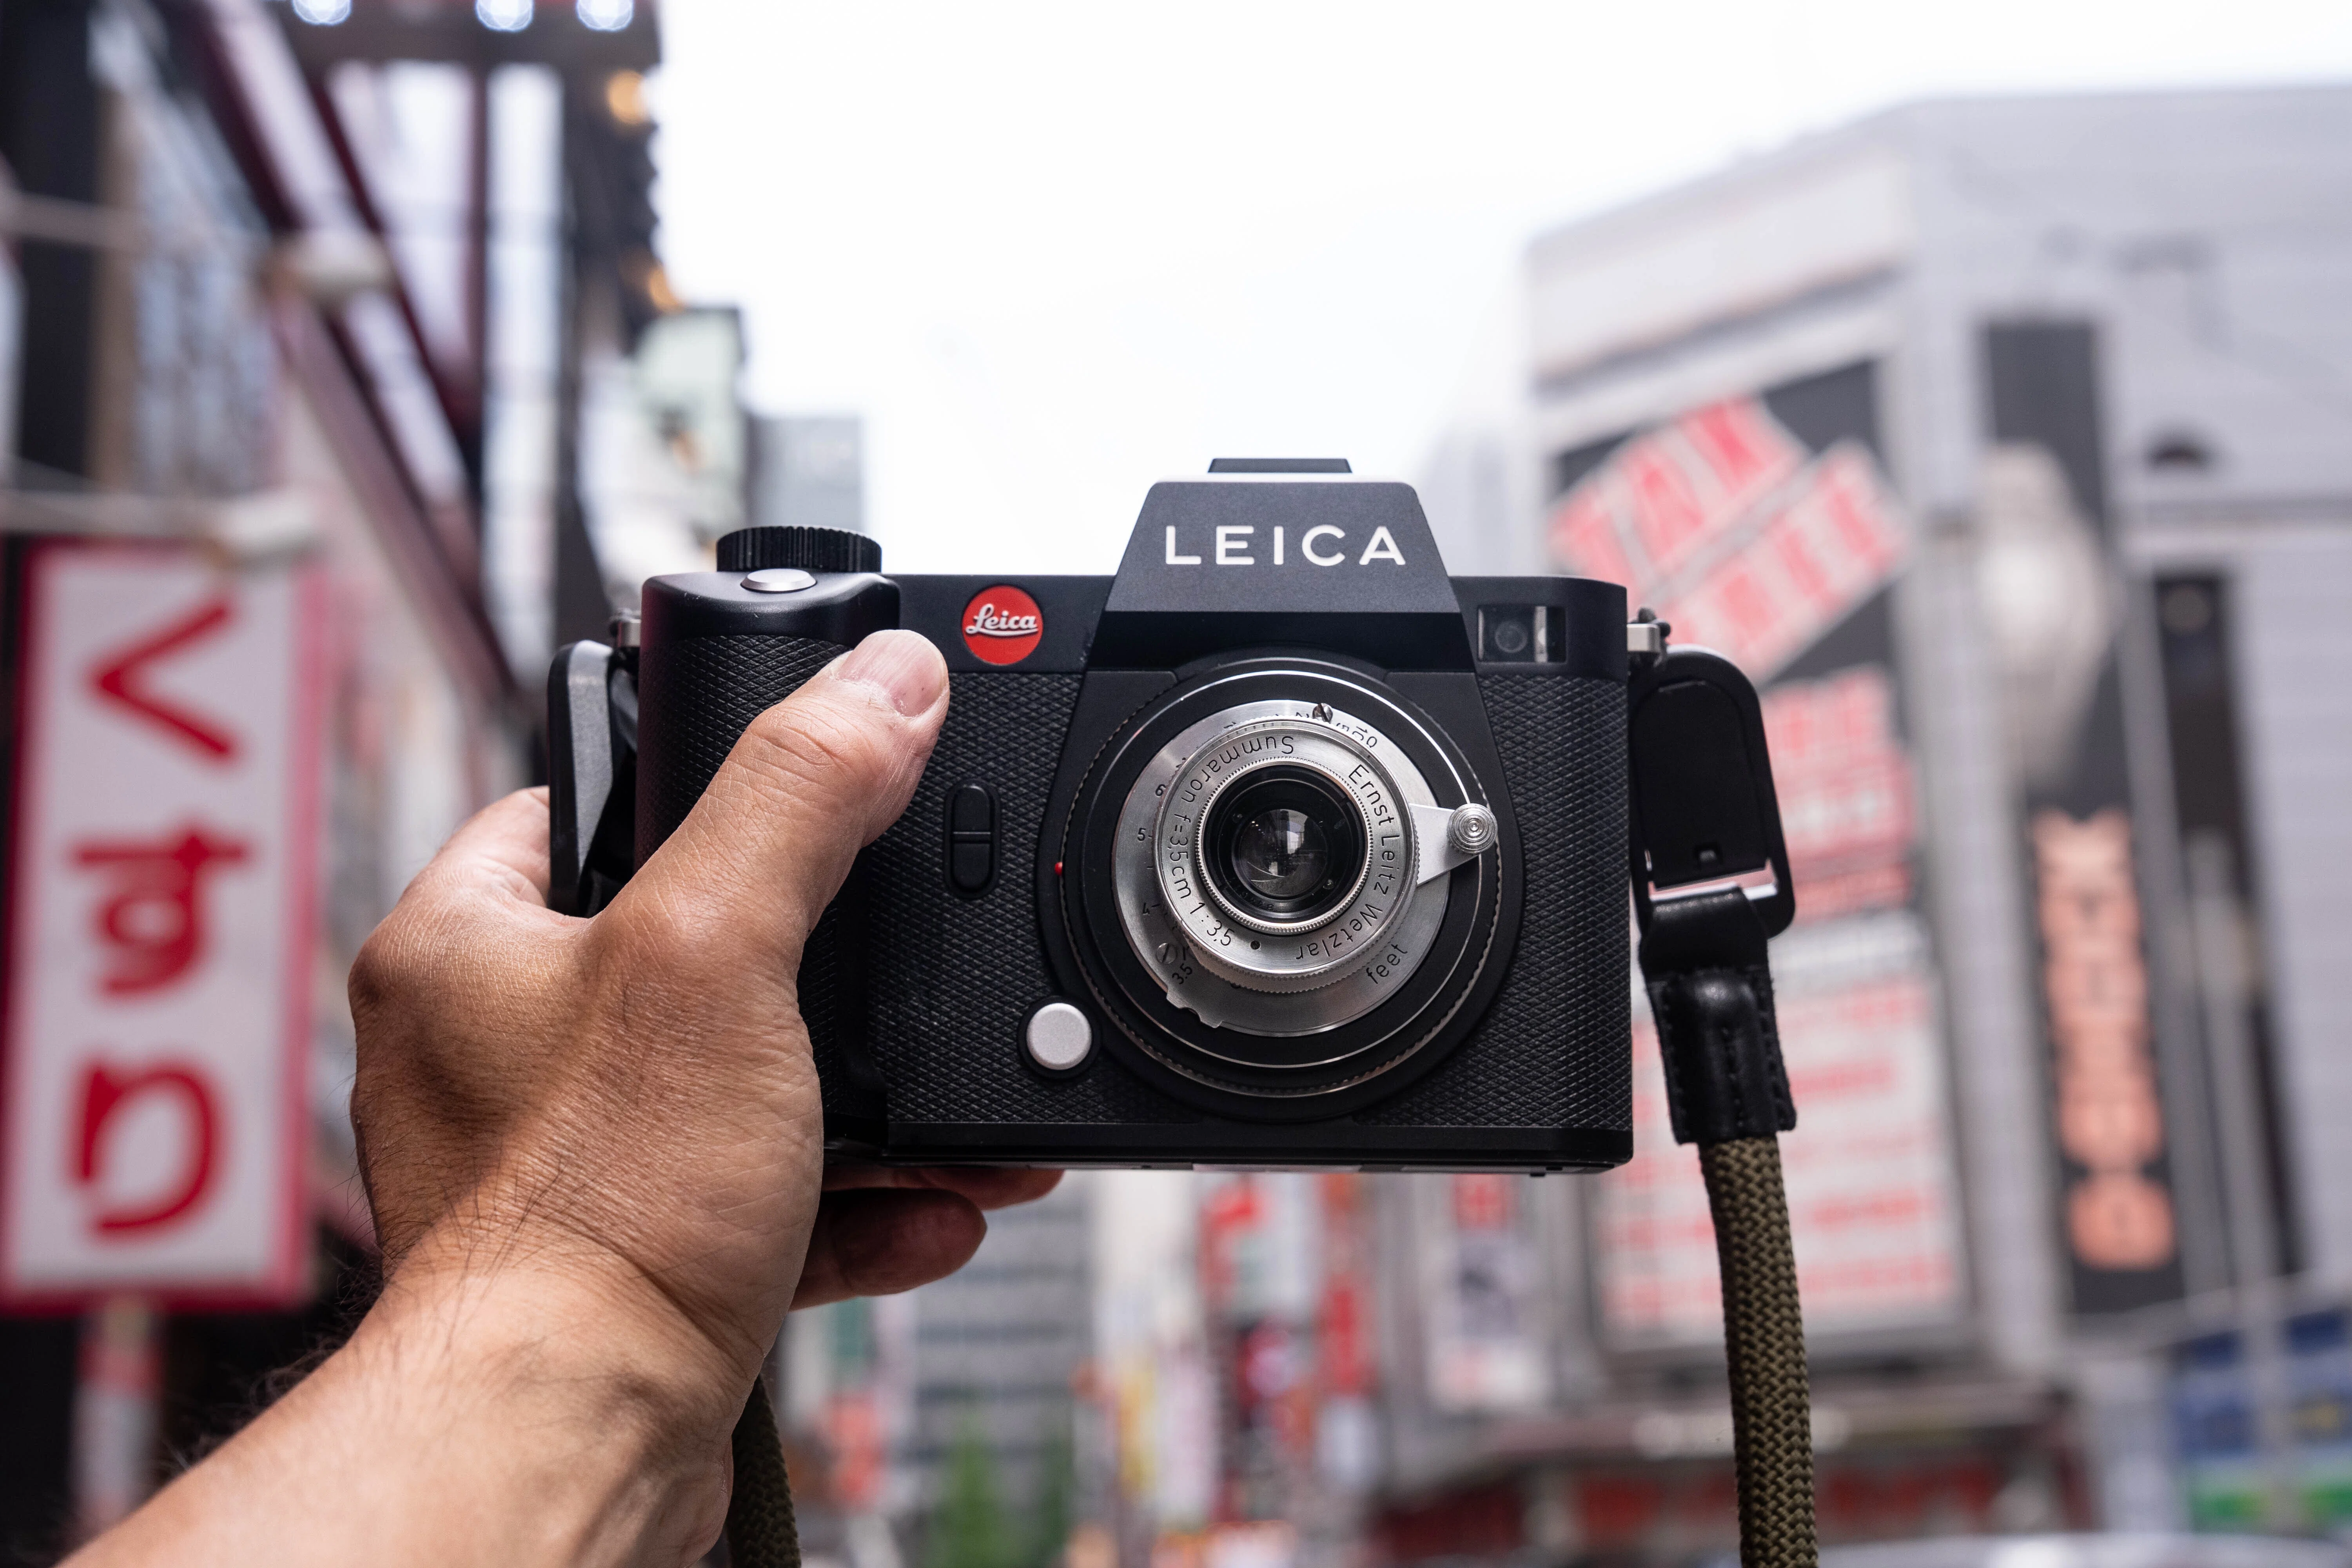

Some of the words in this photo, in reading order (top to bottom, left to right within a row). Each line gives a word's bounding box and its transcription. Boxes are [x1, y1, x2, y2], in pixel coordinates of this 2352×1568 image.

[1165, 524, 1406, 566] LEICA
[965, 603, 1038, 636] Leica
[1181, 736, 1294, 803] Summaron
[1348, 764, 1394, 826] Ernst
[1137, 828, 1146, 842] 5
[1374, 835, 1400, 895] Leitz
[73, 598, 251, 1245] くすり
[1142, 903, 1150, 915] 4
[1295, 904, 1383, 960] Wetzlar
[1171, 963, 1193, 985] 3.5
[1366, 944, 1408, 984] feet
